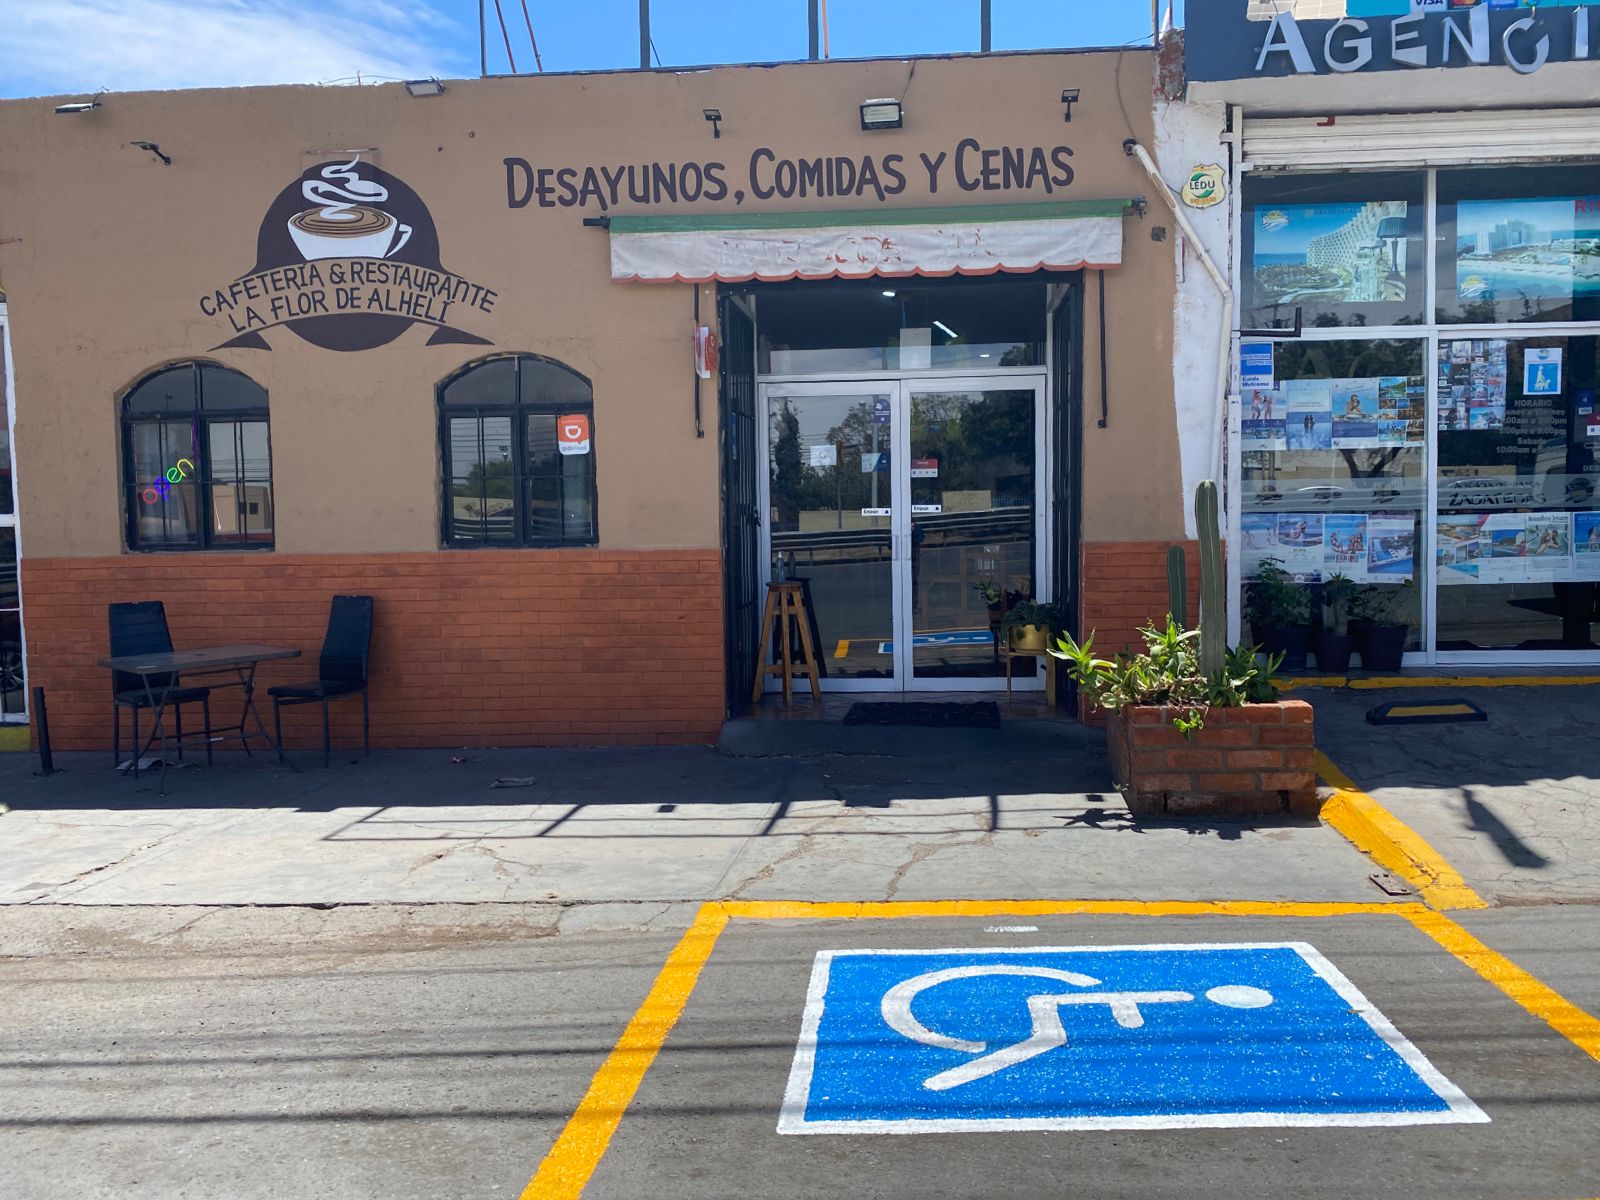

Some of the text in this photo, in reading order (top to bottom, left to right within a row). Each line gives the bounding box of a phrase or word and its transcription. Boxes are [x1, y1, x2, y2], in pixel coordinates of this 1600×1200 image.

[749, 147, 907, 201] COMIDAS
[920, 151, 948, 193] Y
[954, 138, 1075, 194] CENAS
[1189, 180, 1216, 190] LEDU
[329, 263, 347, 285] &
[228, 305, 267, 333] LA
[270, 289, 329, 320] FLOR
[335, 287, 361, 310] DE
[1515, 399, 1553, 407] HORARIO
[143, 458, 194, 505] open
